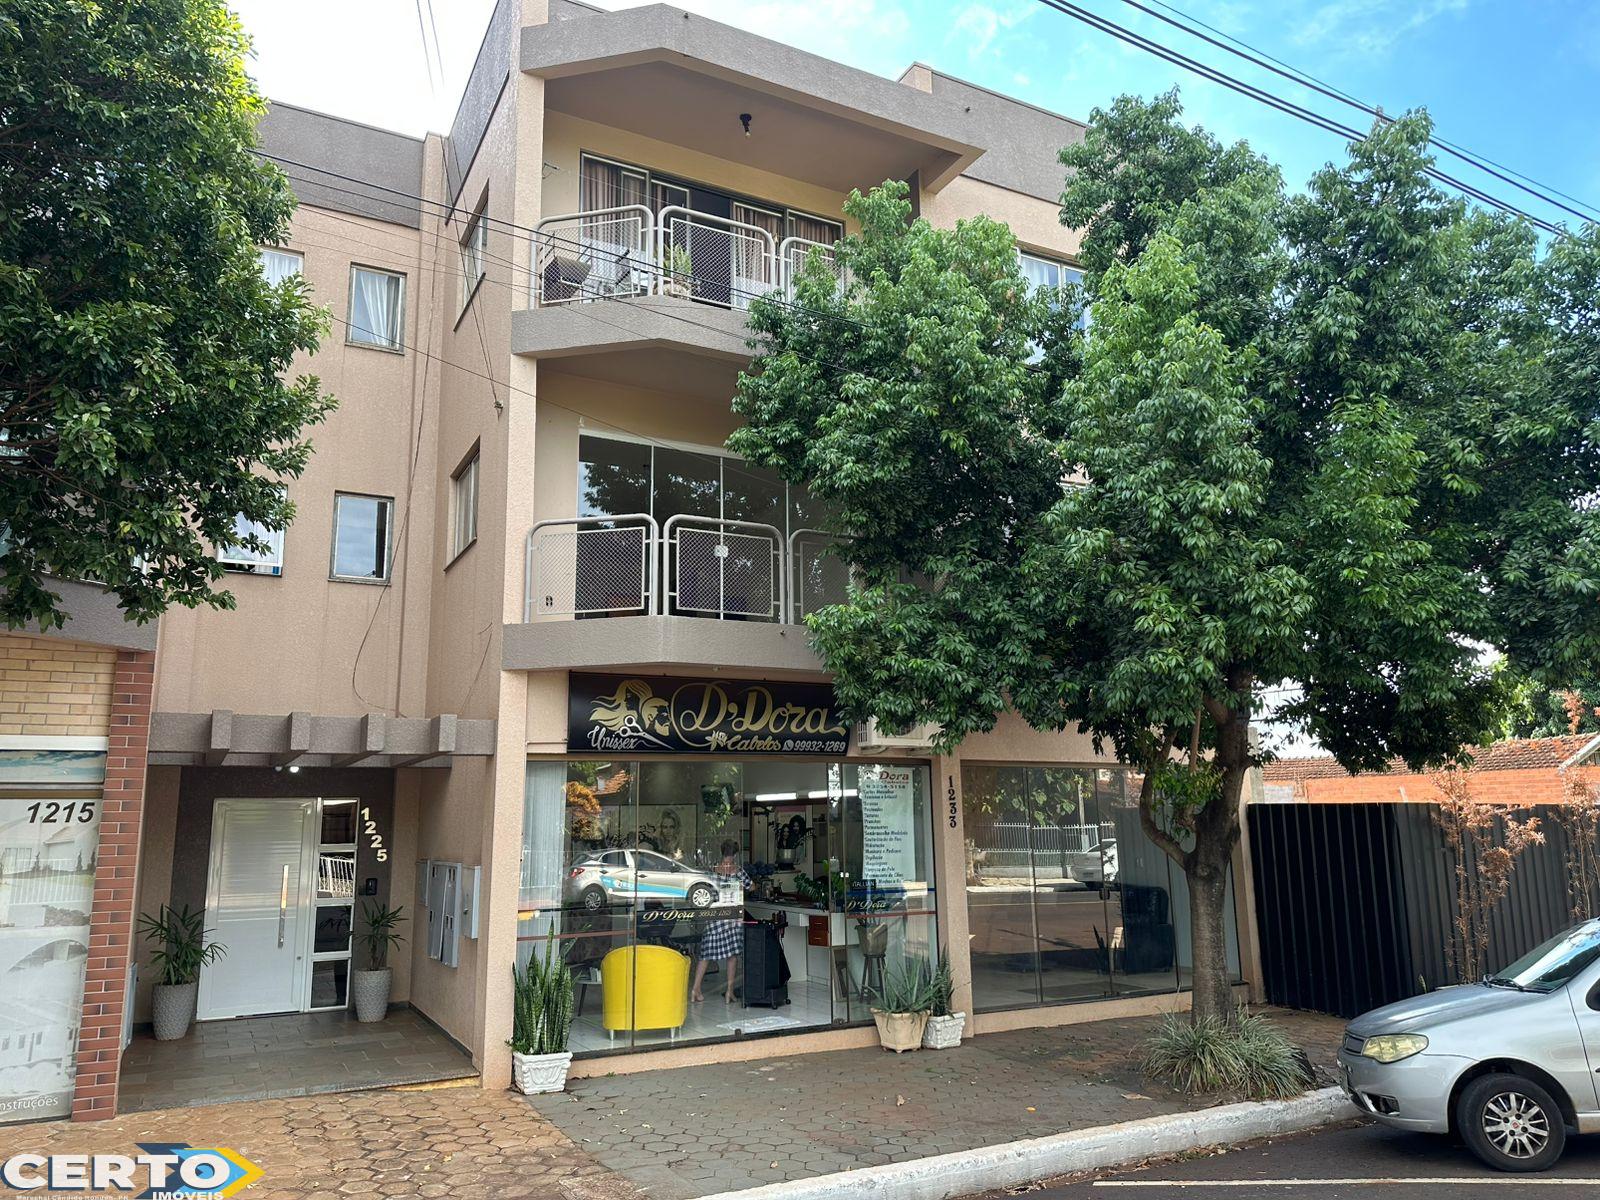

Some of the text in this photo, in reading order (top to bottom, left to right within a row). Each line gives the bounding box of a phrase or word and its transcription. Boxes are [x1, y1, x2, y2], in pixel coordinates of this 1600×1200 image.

[587, 725, 640, 751] Unissex
[726, 734, 782, 751] Cabelos
[879, 771, 909, 780] Dora
[27, 801, 95, 824] 1215
[948, 775, 957, 828] 1233
[361, 807, 388, 862] 1225
[642, 910, 695, 922] D'Dora
